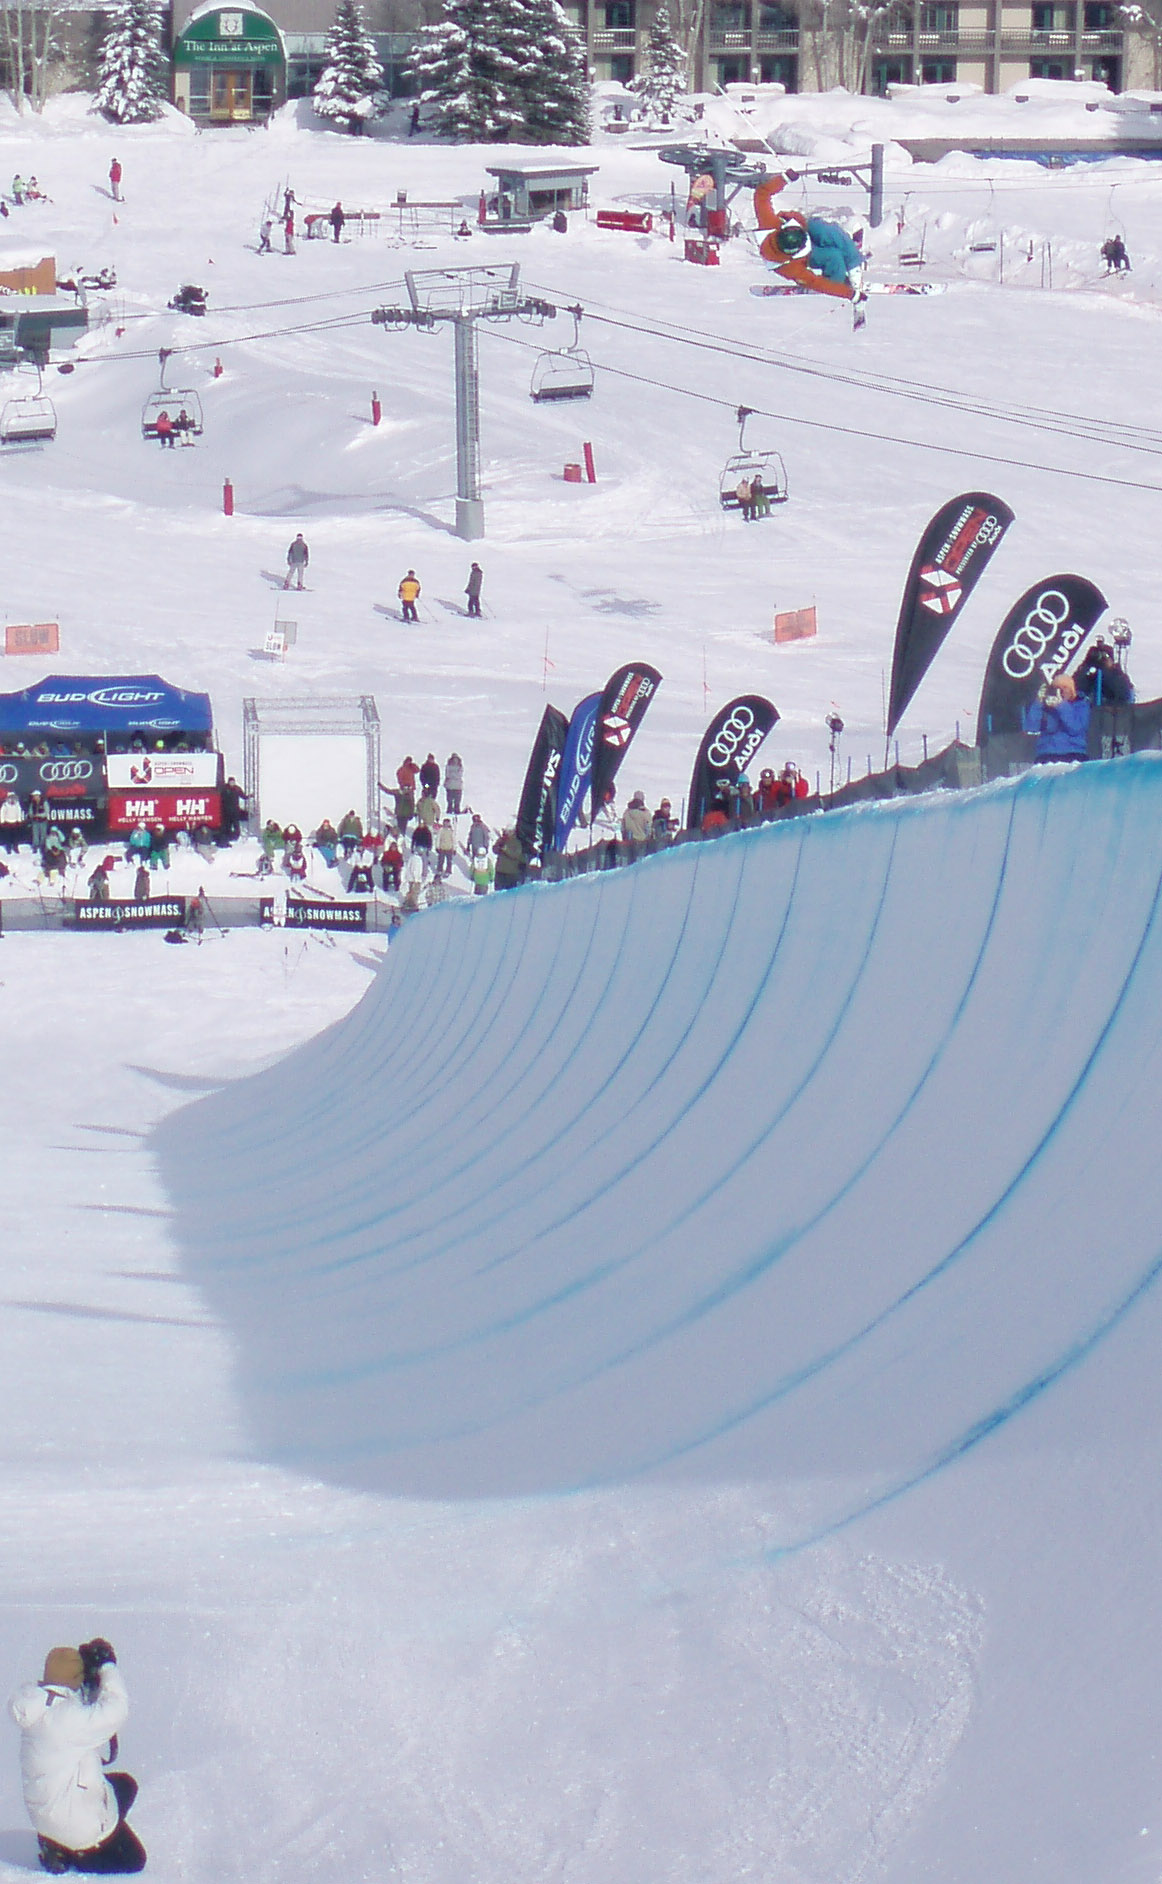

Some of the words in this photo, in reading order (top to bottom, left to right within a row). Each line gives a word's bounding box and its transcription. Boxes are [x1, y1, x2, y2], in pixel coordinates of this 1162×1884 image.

[183, 40, 206, 52] The
[209, 41, 228, 52] Inn
[231, 42, 241, 52] at
[244, 42, 278, 55] Aspen
[1040, 623, 1085, 685] Audi
[37, 692, 87, 703] BUD
[99, 692, 165, 702] LIGHT
[734, 728, 765, 772] Audi
[559, 773, 581, 824] BUD
[125, 800, 154, 816] HH
[176, 799, 205, 816] HH
[80, 907, 112, 919] ASPEN
